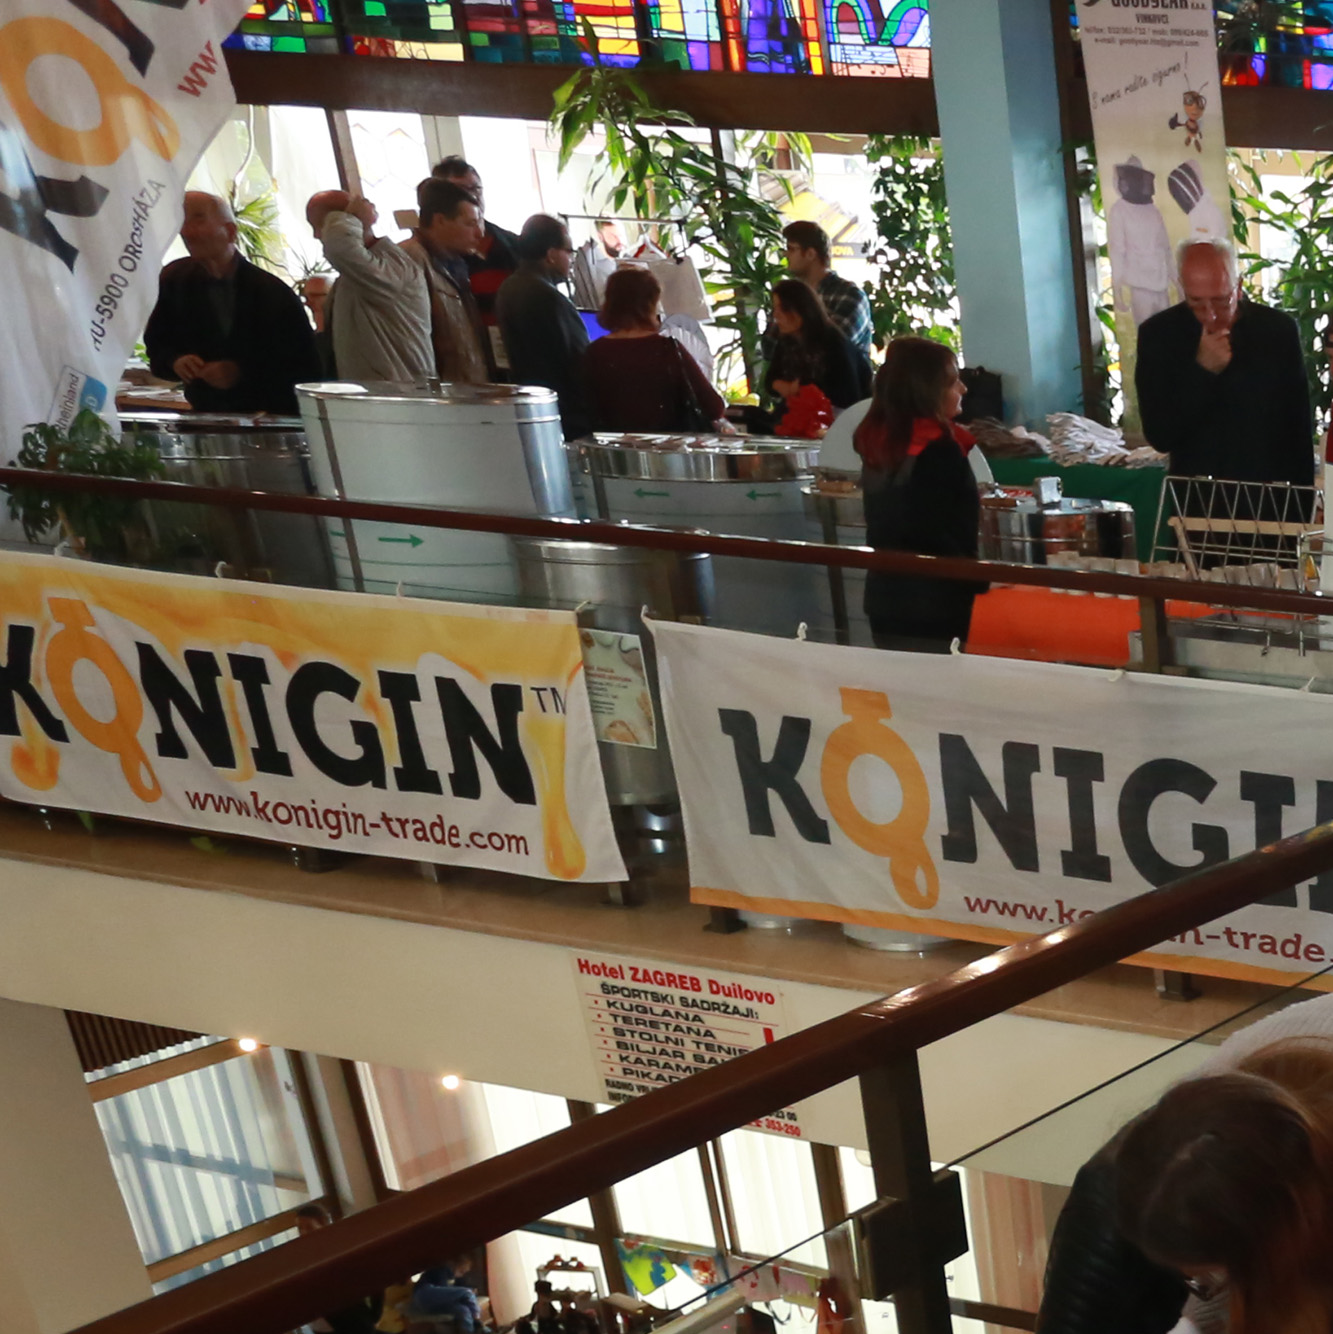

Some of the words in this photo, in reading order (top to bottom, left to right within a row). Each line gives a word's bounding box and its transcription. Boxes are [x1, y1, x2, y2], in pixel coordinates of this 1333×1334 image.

[184, 788, 530, 857] www.konigin-trade.com
[577, 958, 625, 981] Hotel
[628, 966, 702, 993] ZAGREB
[708, 979, 775, 1005] Duilovo
[600, 982, 675, 1006] ŠPORTSKI
[679, 995, 759, 1020] SADRŽAJI:
[606, 999, 705, 1025] KUGLANA
[609, 1013, 717, 1040] TERETANA
[612, 1026, 685, 1047] STOLNI
[615, 1040, 686, 1061] BILJAR
